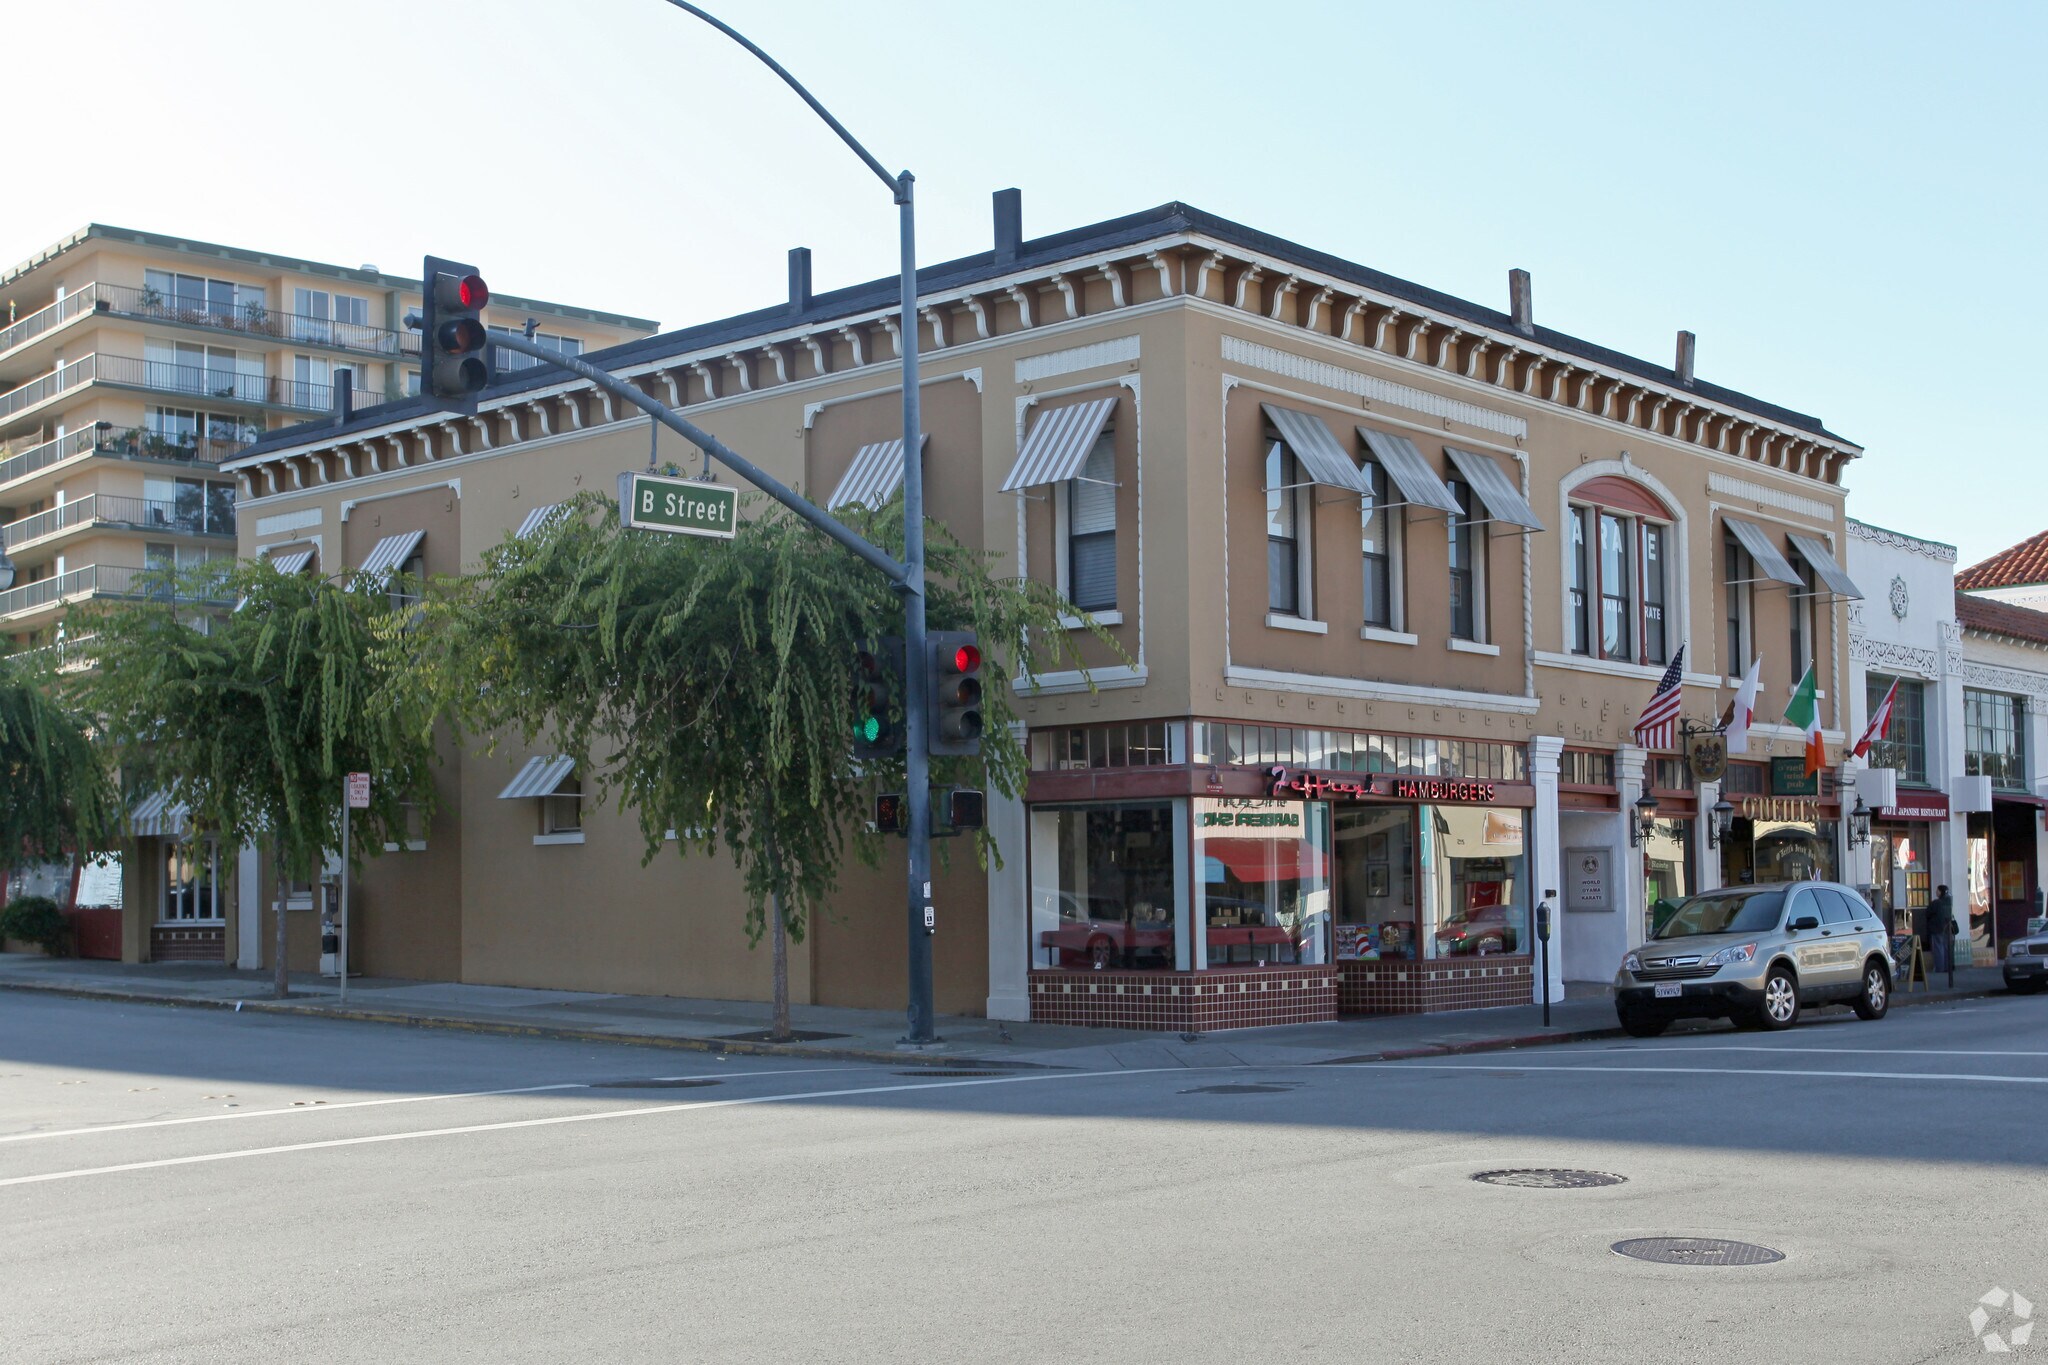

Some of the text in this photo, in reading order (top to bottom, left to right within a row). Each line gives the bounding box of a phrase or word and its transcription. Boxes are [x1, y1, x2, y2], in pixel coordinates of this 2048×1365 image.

[642, 489, 727, 523] B Street
[1396, 780, 1496, 801] HAMBURGERS
[1742, 796, 1820, 823] O'NEILL'S
[1920, 808, 1947, 818] RESTAURANT
